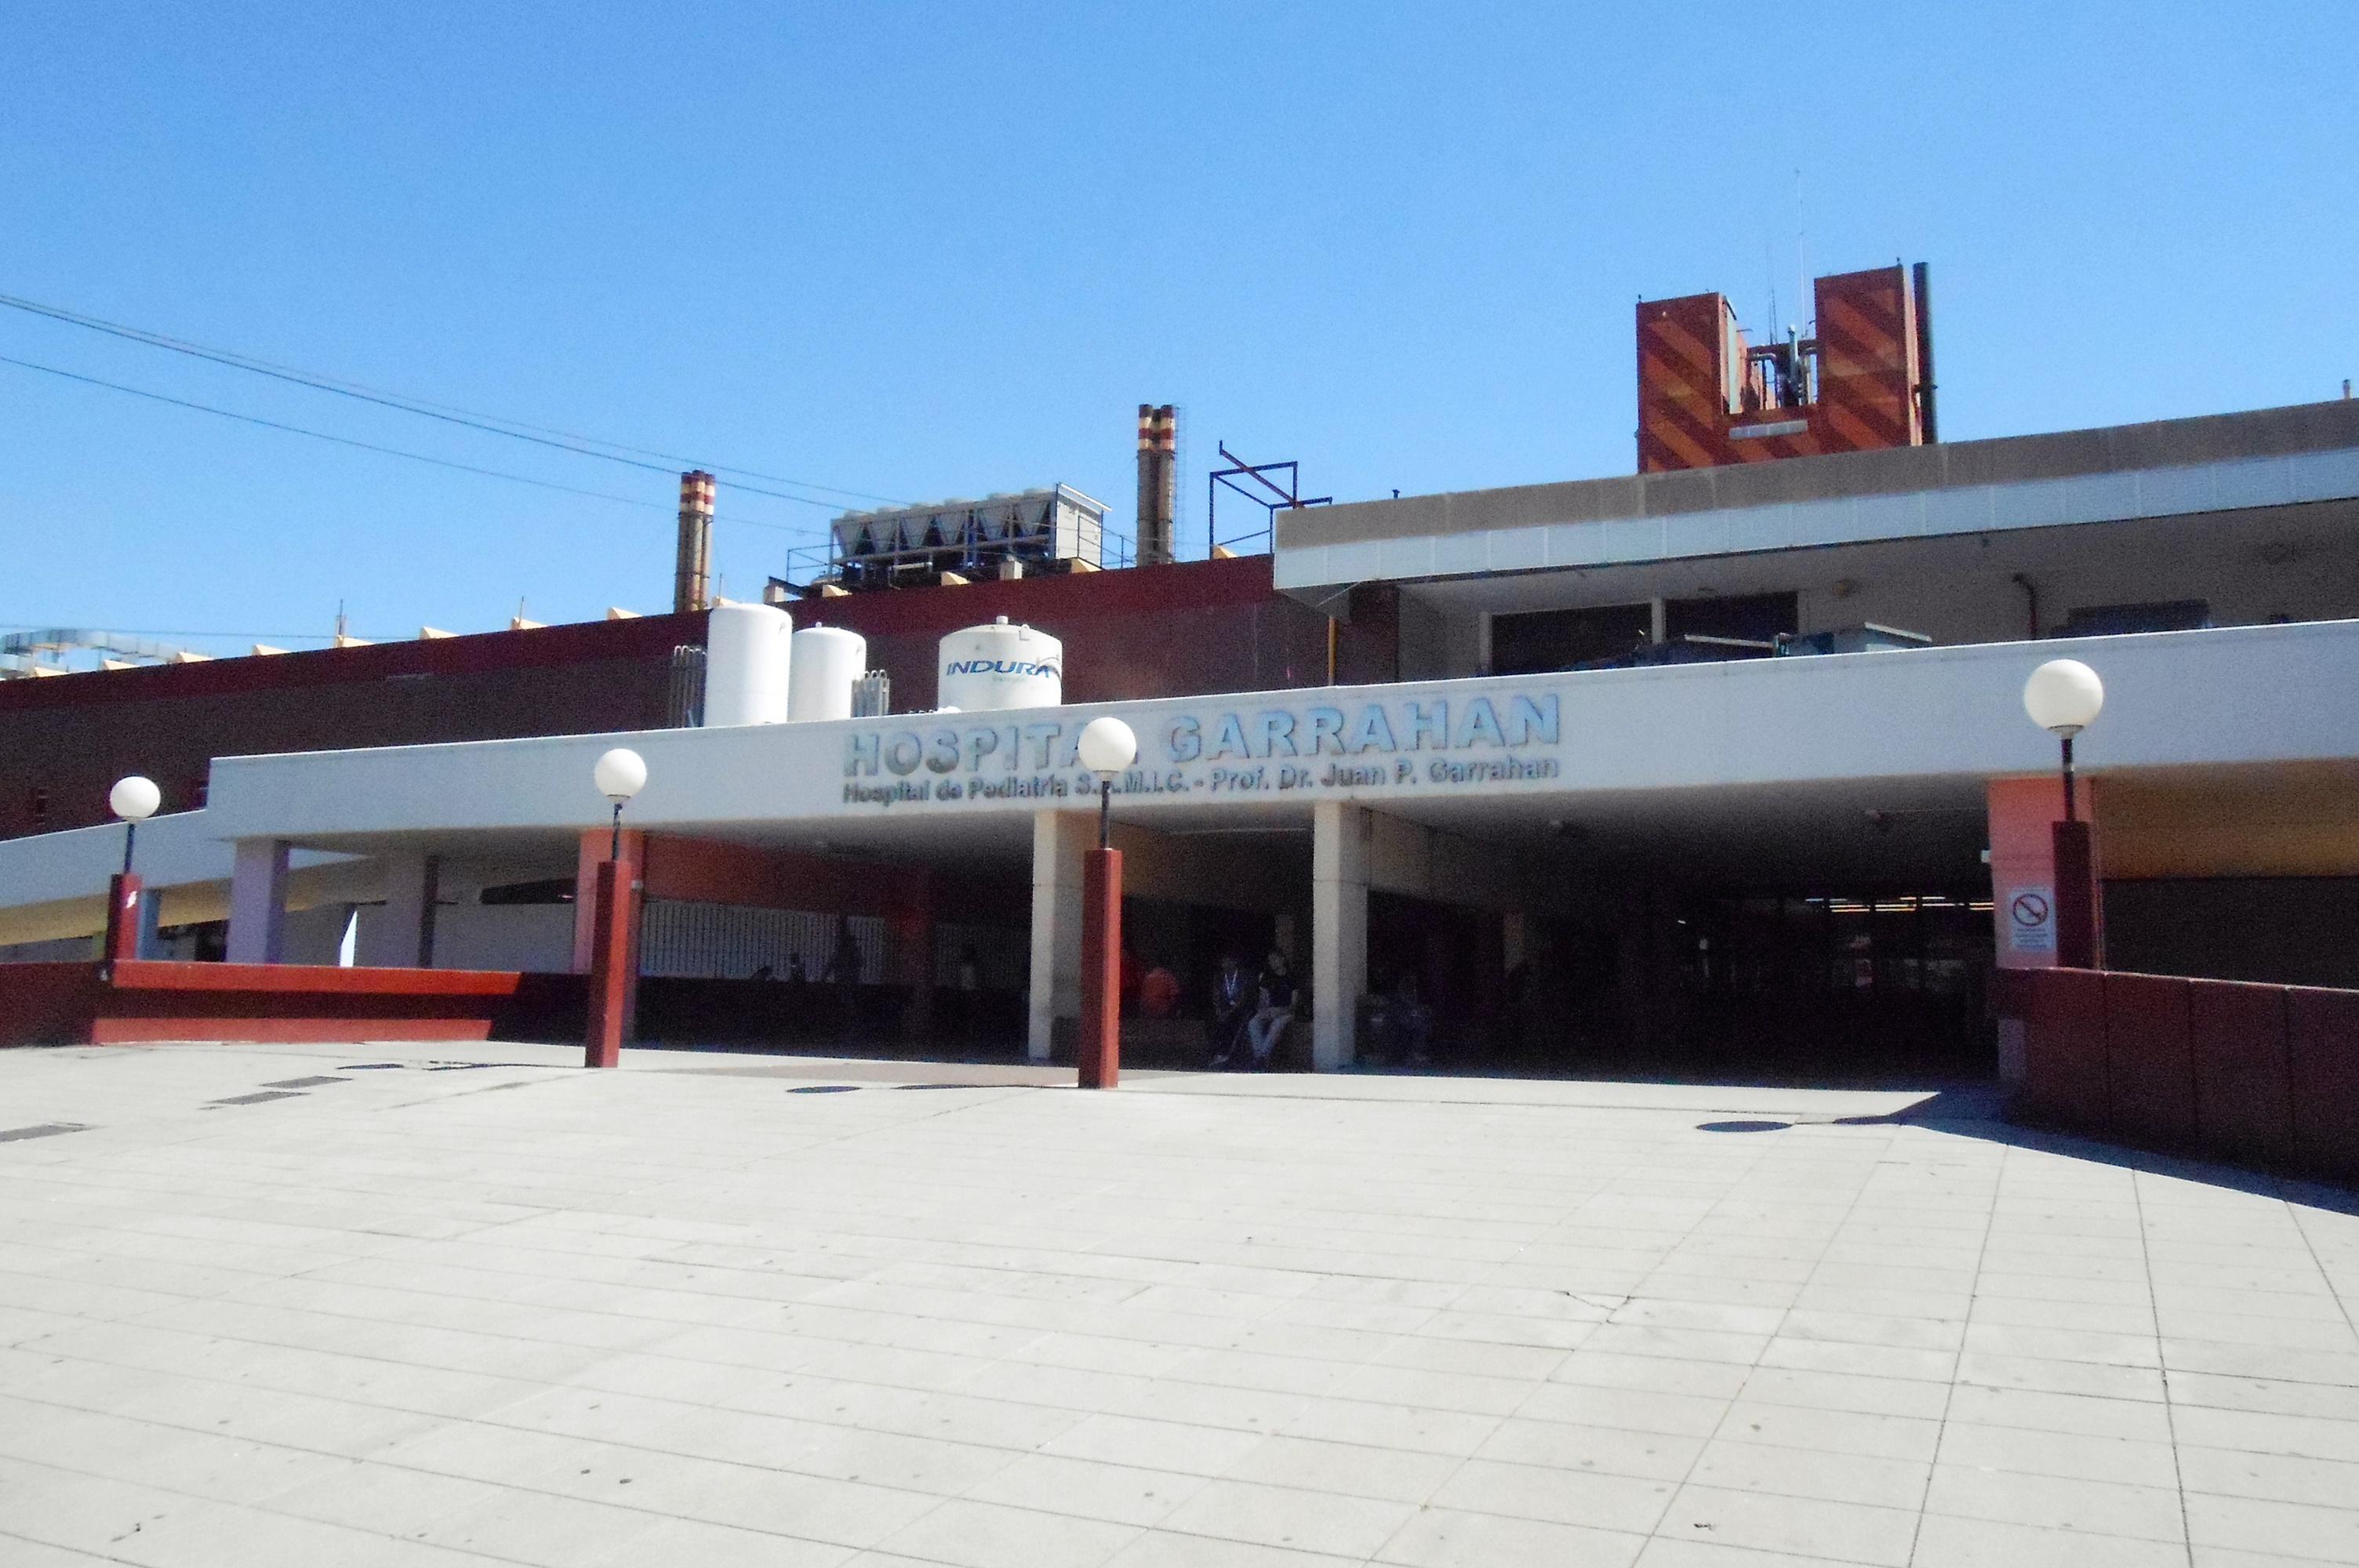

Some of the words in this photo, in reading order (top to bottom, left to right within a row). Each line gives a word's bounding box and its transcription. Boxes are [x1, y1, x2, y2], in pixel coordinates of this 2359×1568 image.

[947, 660, 1049, 678] INDURA
[844, 722, 1139, 777] HOSPIT
[1168, 694, 1559, 762] GARRAHAN
[843, 780, 929, 807] Hospital
[936, 779, 962, 800] de
[1075, 771, 1190, 795] S..M.I.C.
[1212, 765, 1269, 791] Prof.
[1279, 764, 1313, 789] Dr.
[1321, 762, 1386, 787] Juan
[1395, 758, 1417, 784] P.
[1430, 754, 1558, 782] Garrahan
